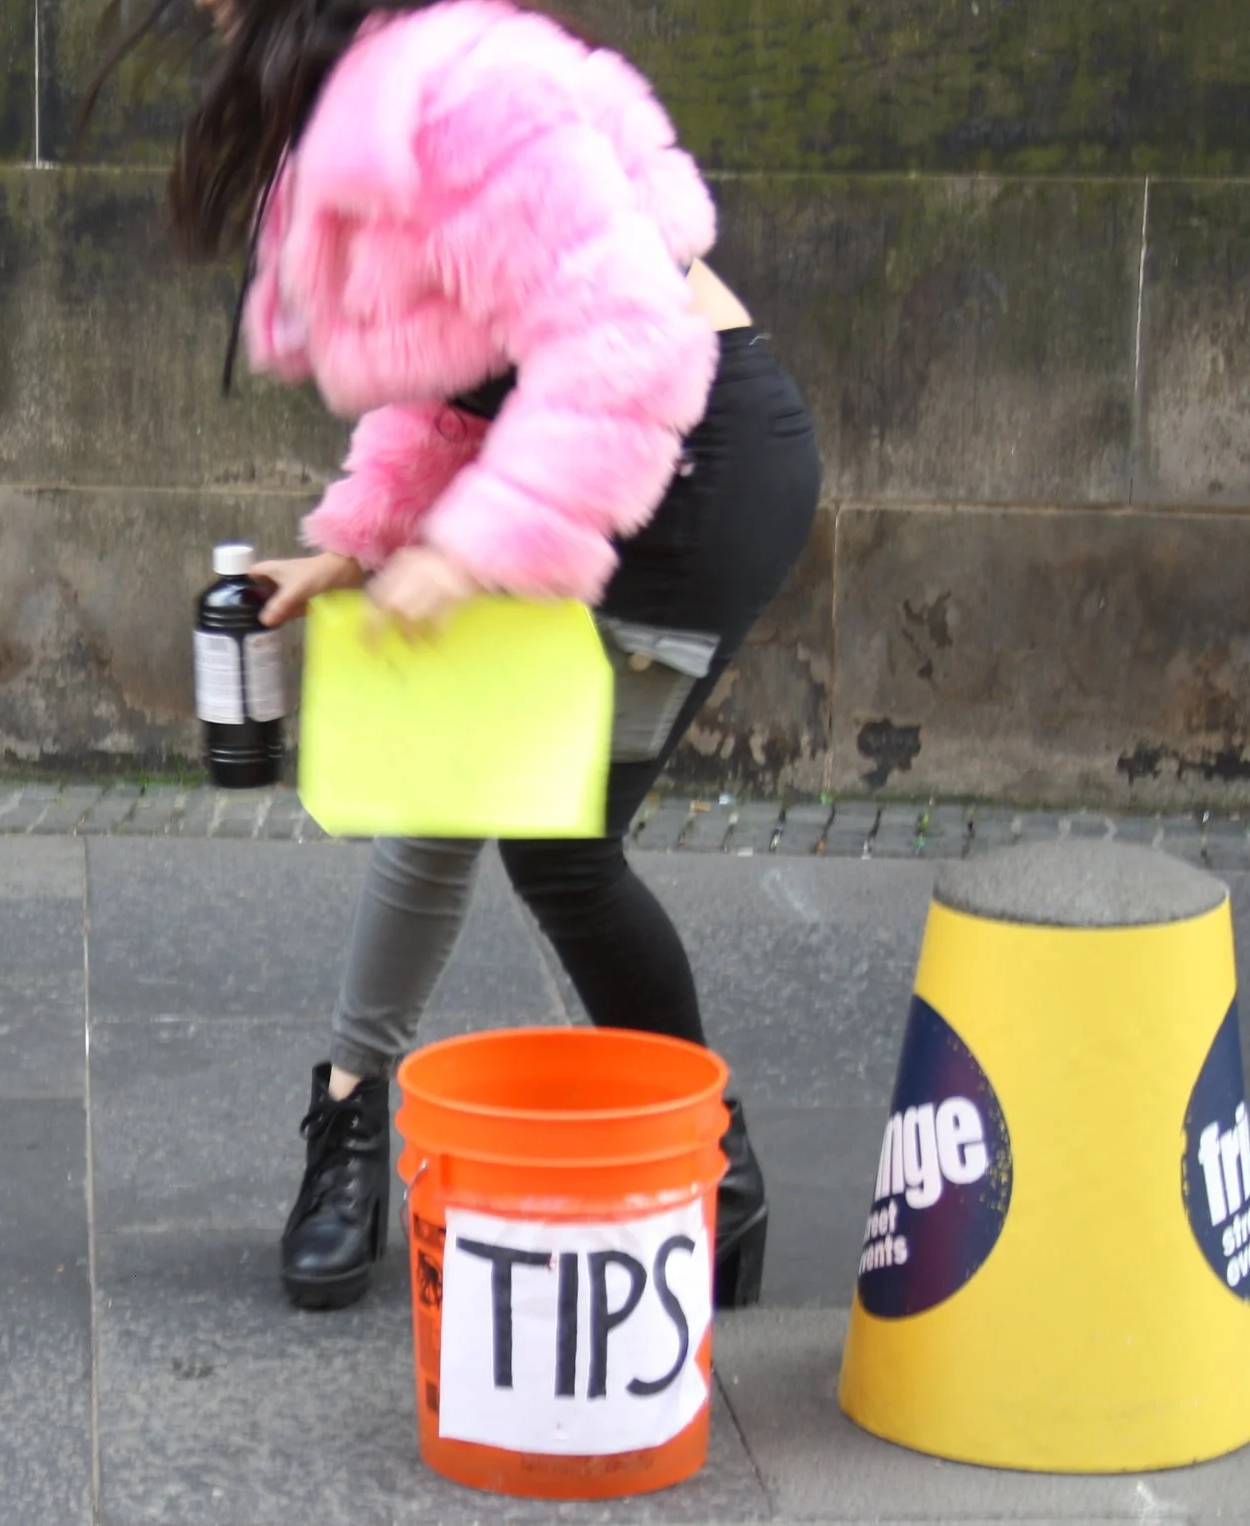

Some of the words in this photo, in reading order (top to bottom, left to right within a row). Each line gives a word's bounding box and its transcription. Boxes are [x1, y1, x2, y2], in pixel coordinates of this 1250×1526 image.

[1198, 1101, 1250, 1227] fri
[1222, 1207, 1250, 1257] str
[1226, 1243, 1250, 1287] ev
[456, 1234, 696, 1401] TIPS
